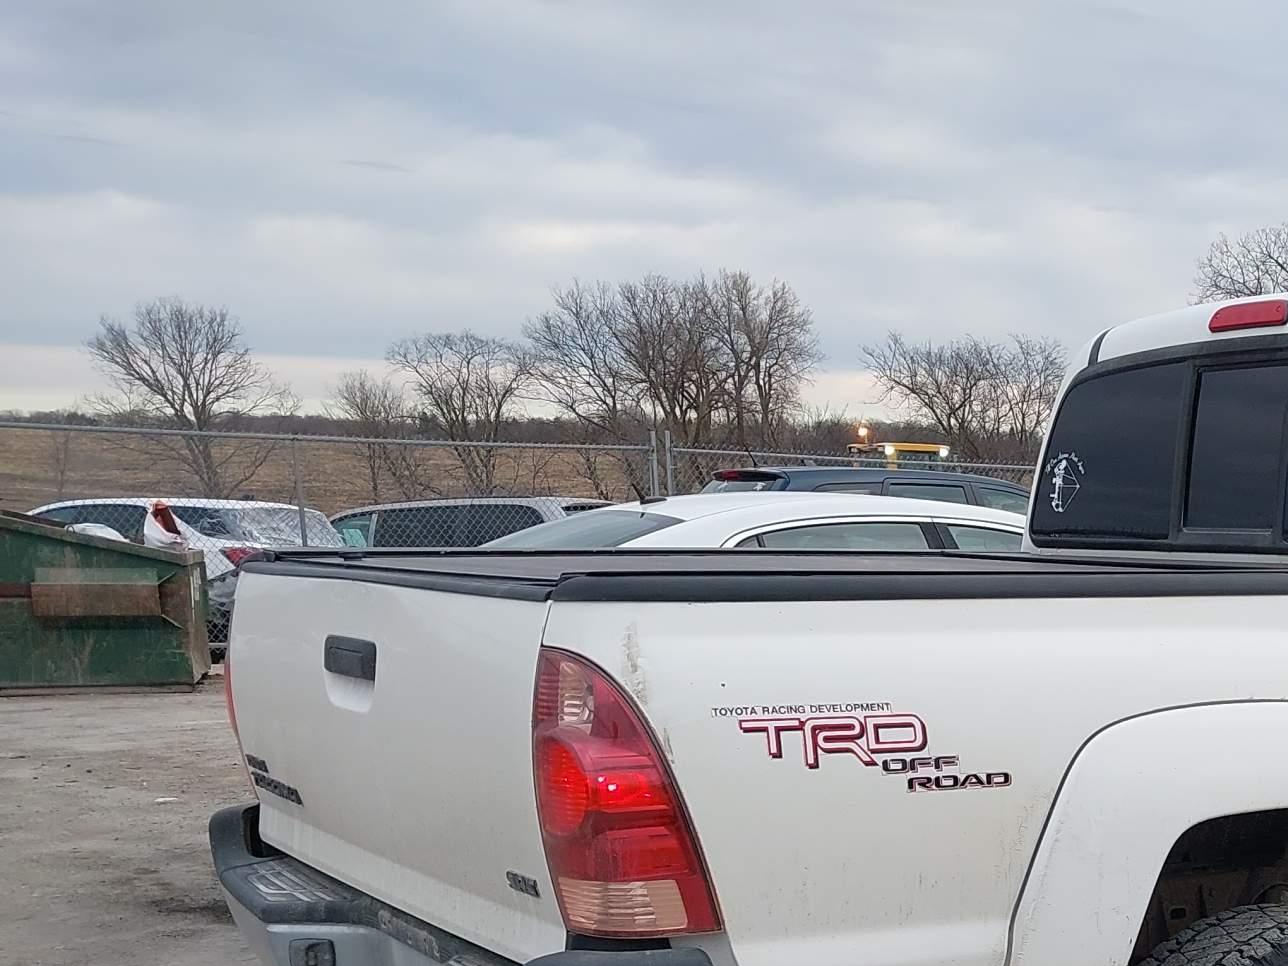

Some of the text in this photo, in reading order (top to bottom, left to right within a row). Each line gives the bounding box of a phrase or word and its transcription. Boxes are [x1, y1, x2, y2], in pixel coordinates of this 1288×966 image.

[712, 702, 891, 717] TOYOTA RACING DEVELOPMENT
[738, 713, 929, 770] TRD
[881, 755, 960, 774] OFF
[906, 771, 1013, 794] ROAD
